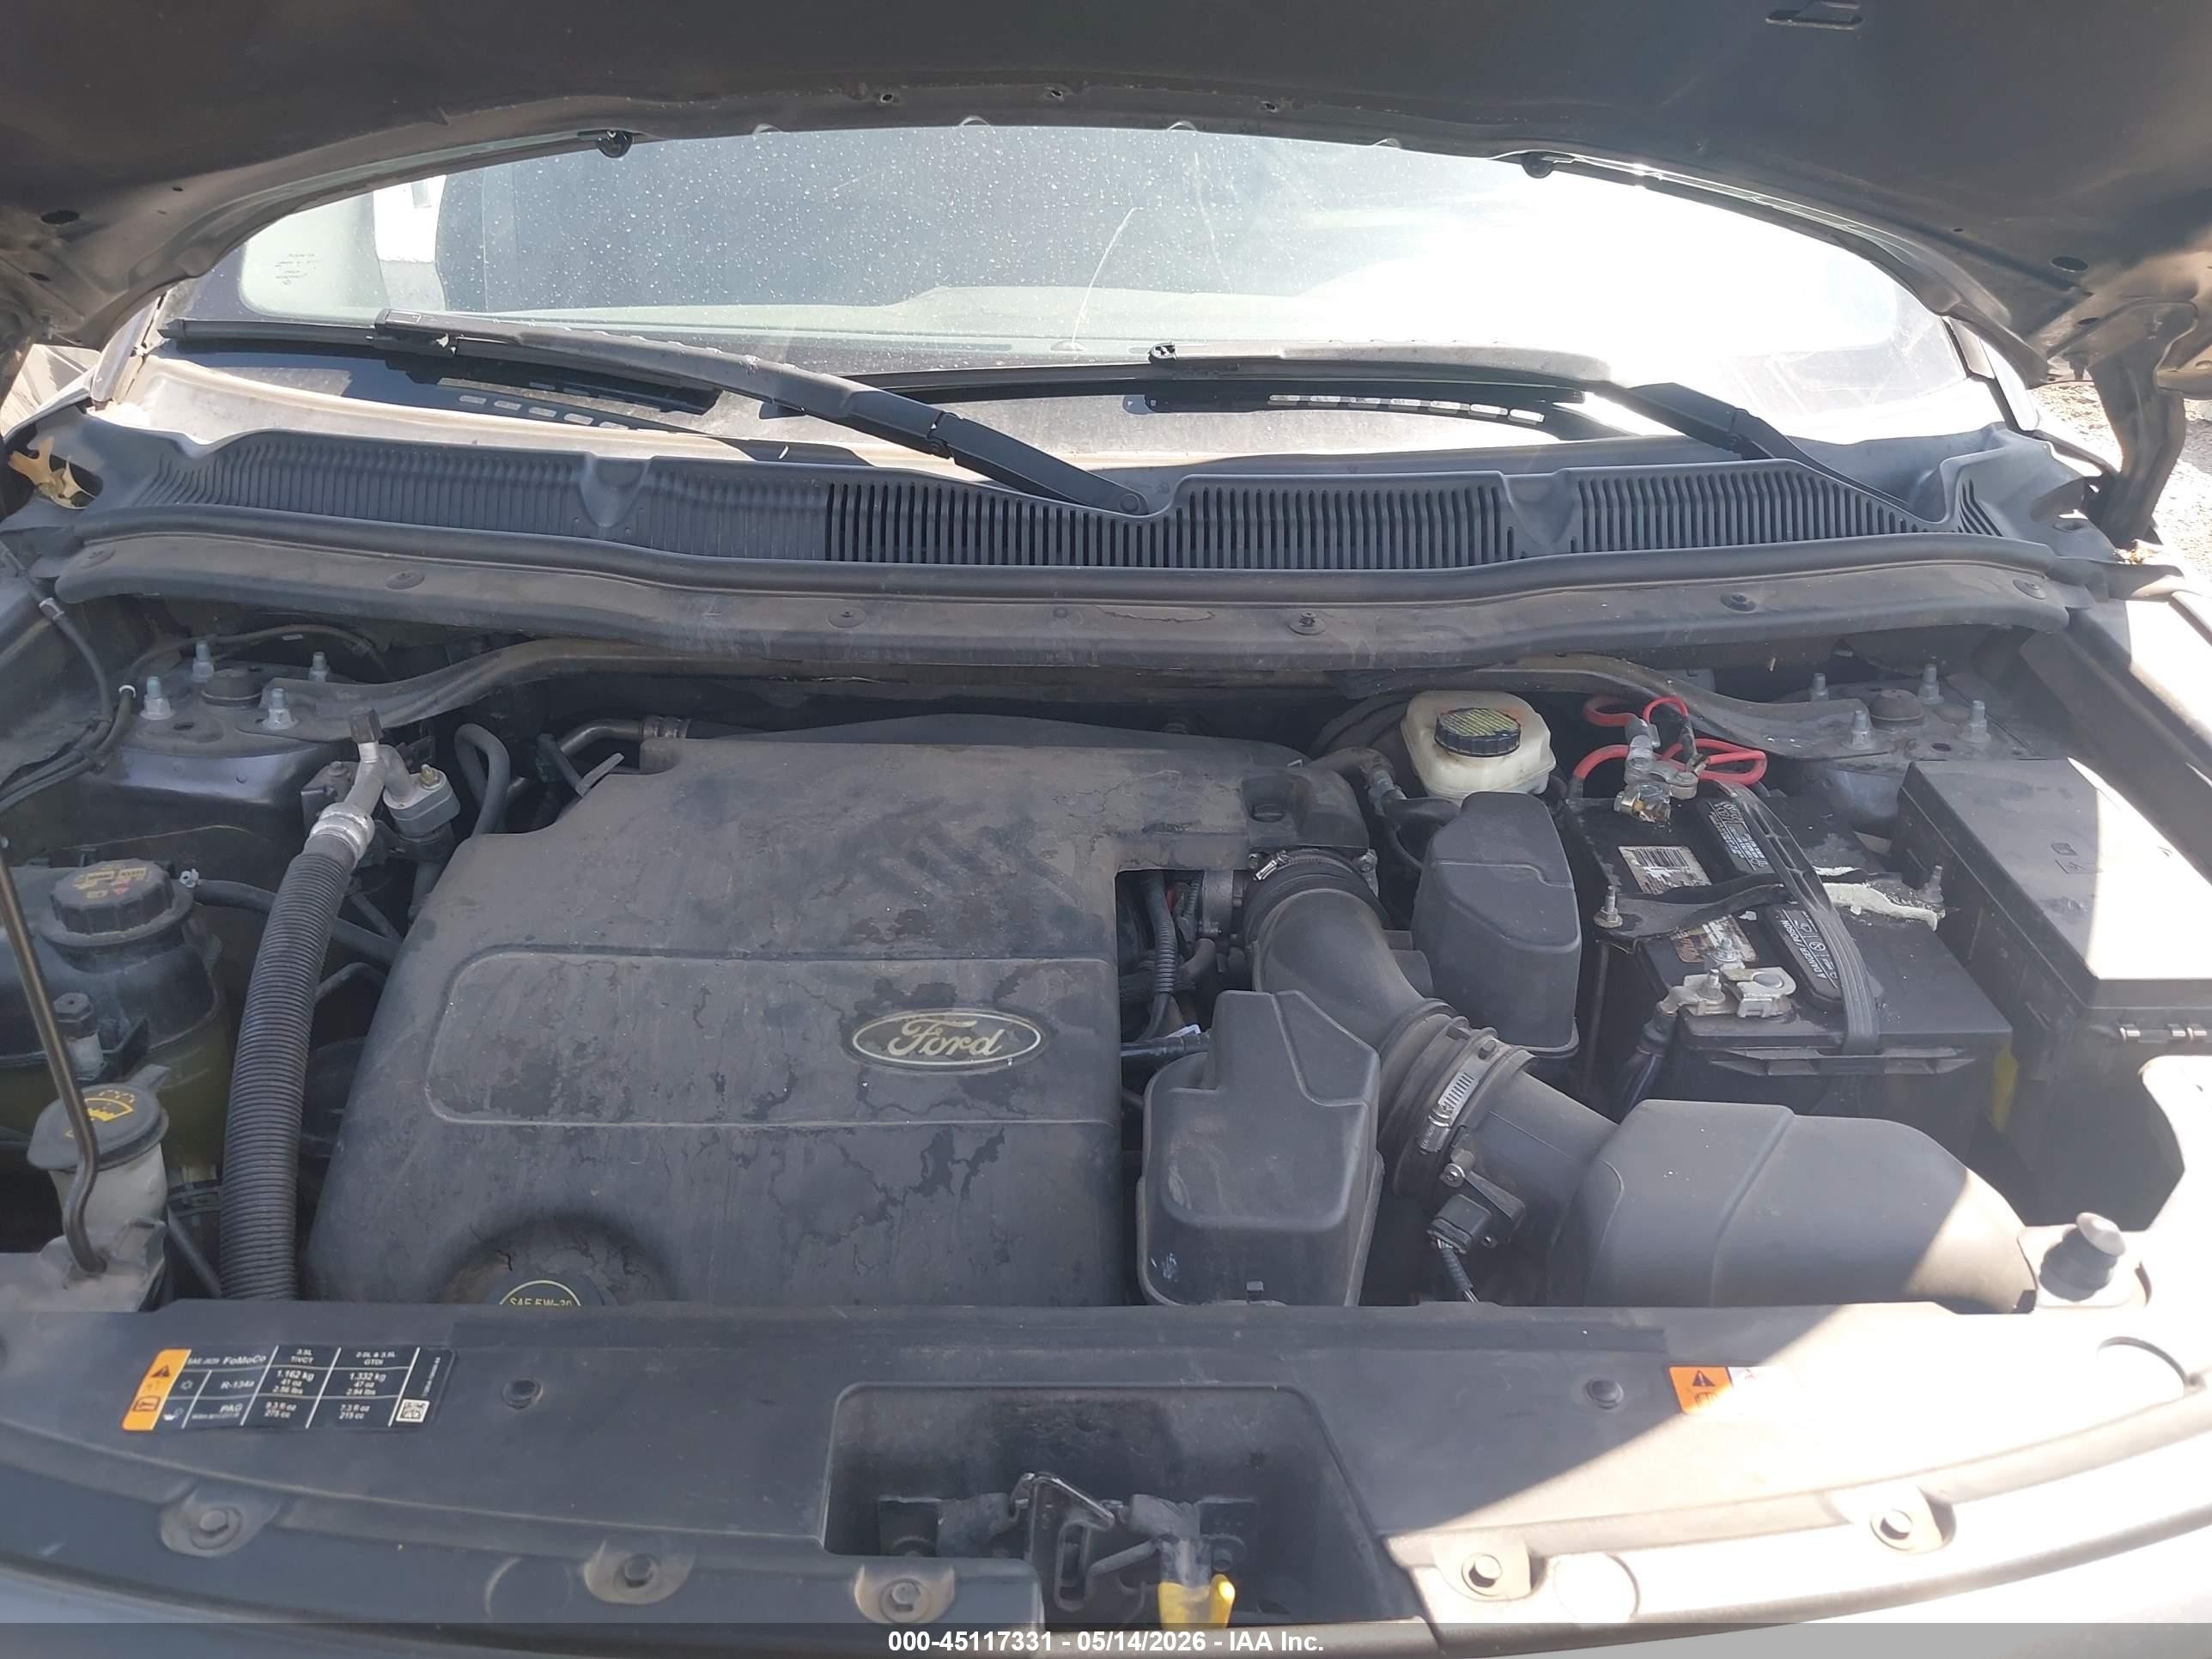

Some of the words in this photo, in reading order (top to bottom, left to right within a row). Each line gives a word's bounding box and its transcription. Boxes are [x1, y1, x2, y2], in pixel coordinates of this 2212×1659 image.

[1780, 920, 1802, 943] POISON
[1800, 947, 1823, 973] DANGER
[886, 1018, 1006, 1056] Ford
[223, 1355, 266, 1365] FoMoCo
[277, 1370, 301, 1379] 1.162
[302, 1371, 315, 1383] kg
[349, 1372, 374, 1381] 1.332
[374, 1373, 386, 1382] kg
[220, 1380, 255, 1389] R-134a
[220, 1403, 243, 1413] PAG
